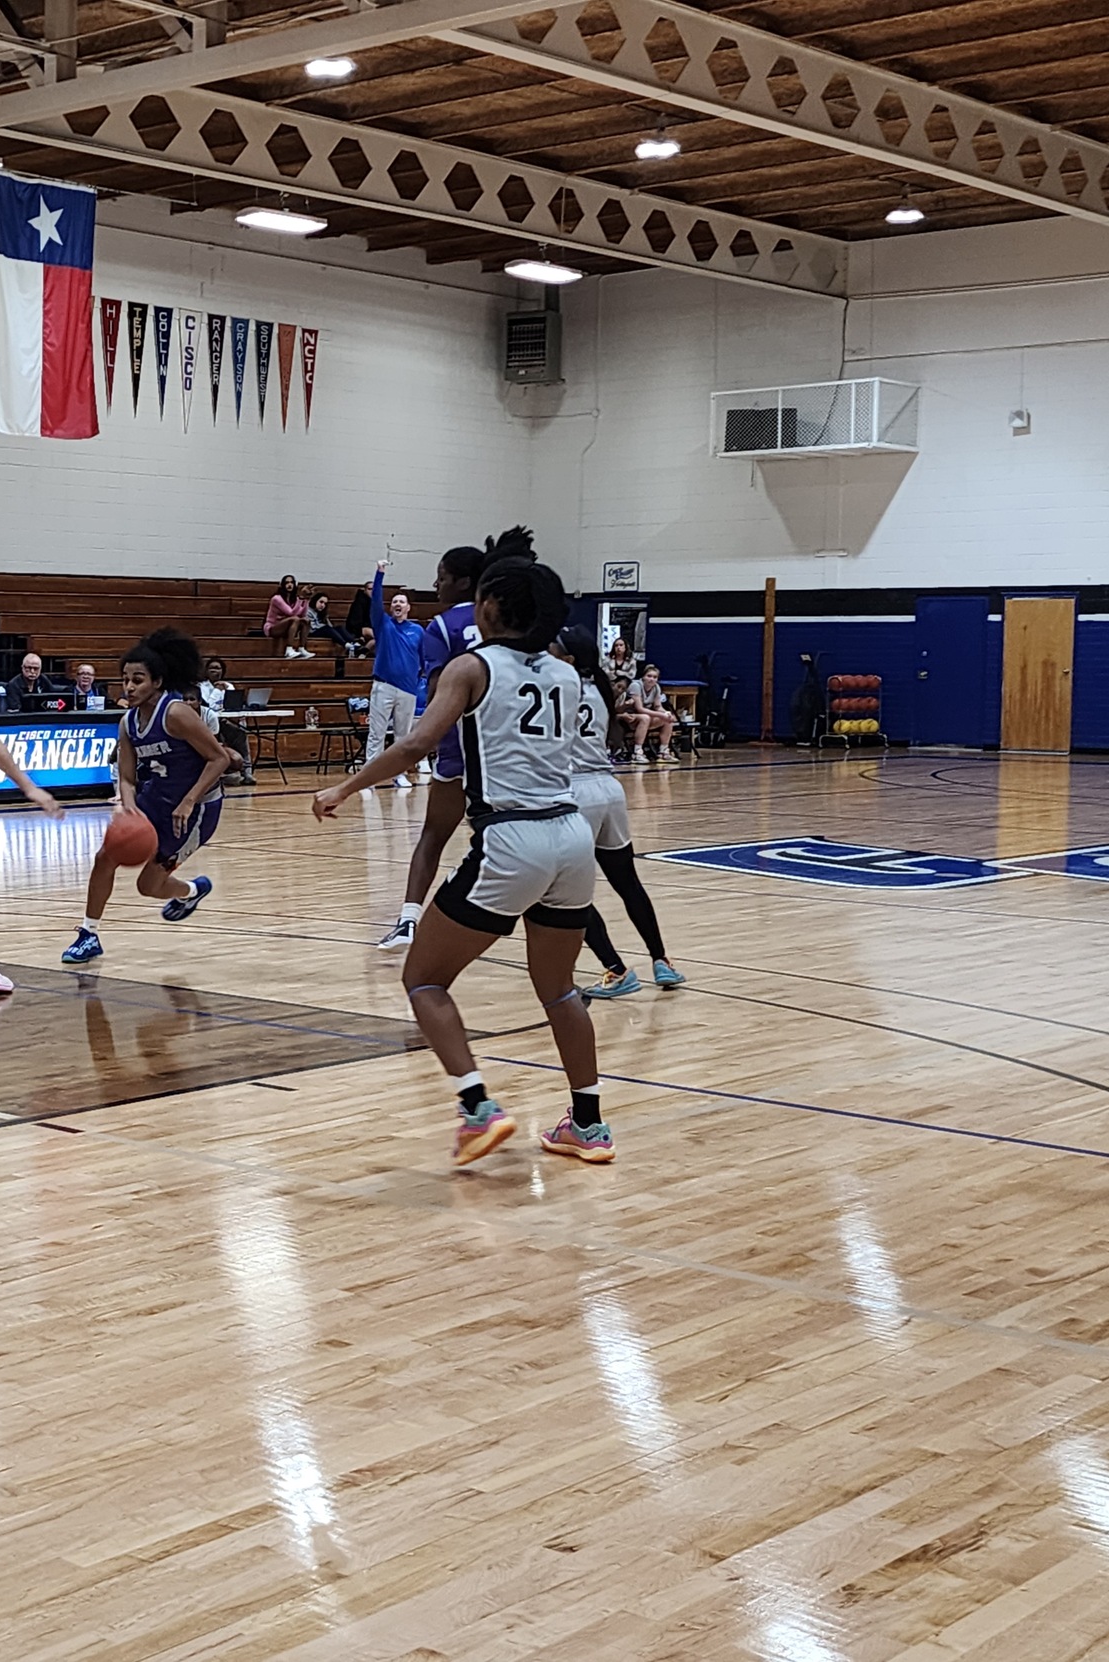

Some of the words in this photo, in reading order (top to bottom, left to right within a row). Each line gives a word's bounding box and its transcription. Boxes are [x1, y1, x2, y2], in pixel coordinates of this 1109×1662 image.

[106, 303, 116, 367] HILL
[132, 307, 143, 374] TEMPLE
[158, 312, 168, 377] COLLIN
[183, 315, 196, 391] CISCO
[212, 318, 221, 385] RANGER
[259, 325, 269, 402] SOUTHWEST
[304, 332, 315, 384] NCTC
[17, 730, 51, 740] CISCO
[53, 728, 97, 739] COLLEGE
[517, 681, 564, 740] 21
[578, 702, 598, 738] 2
